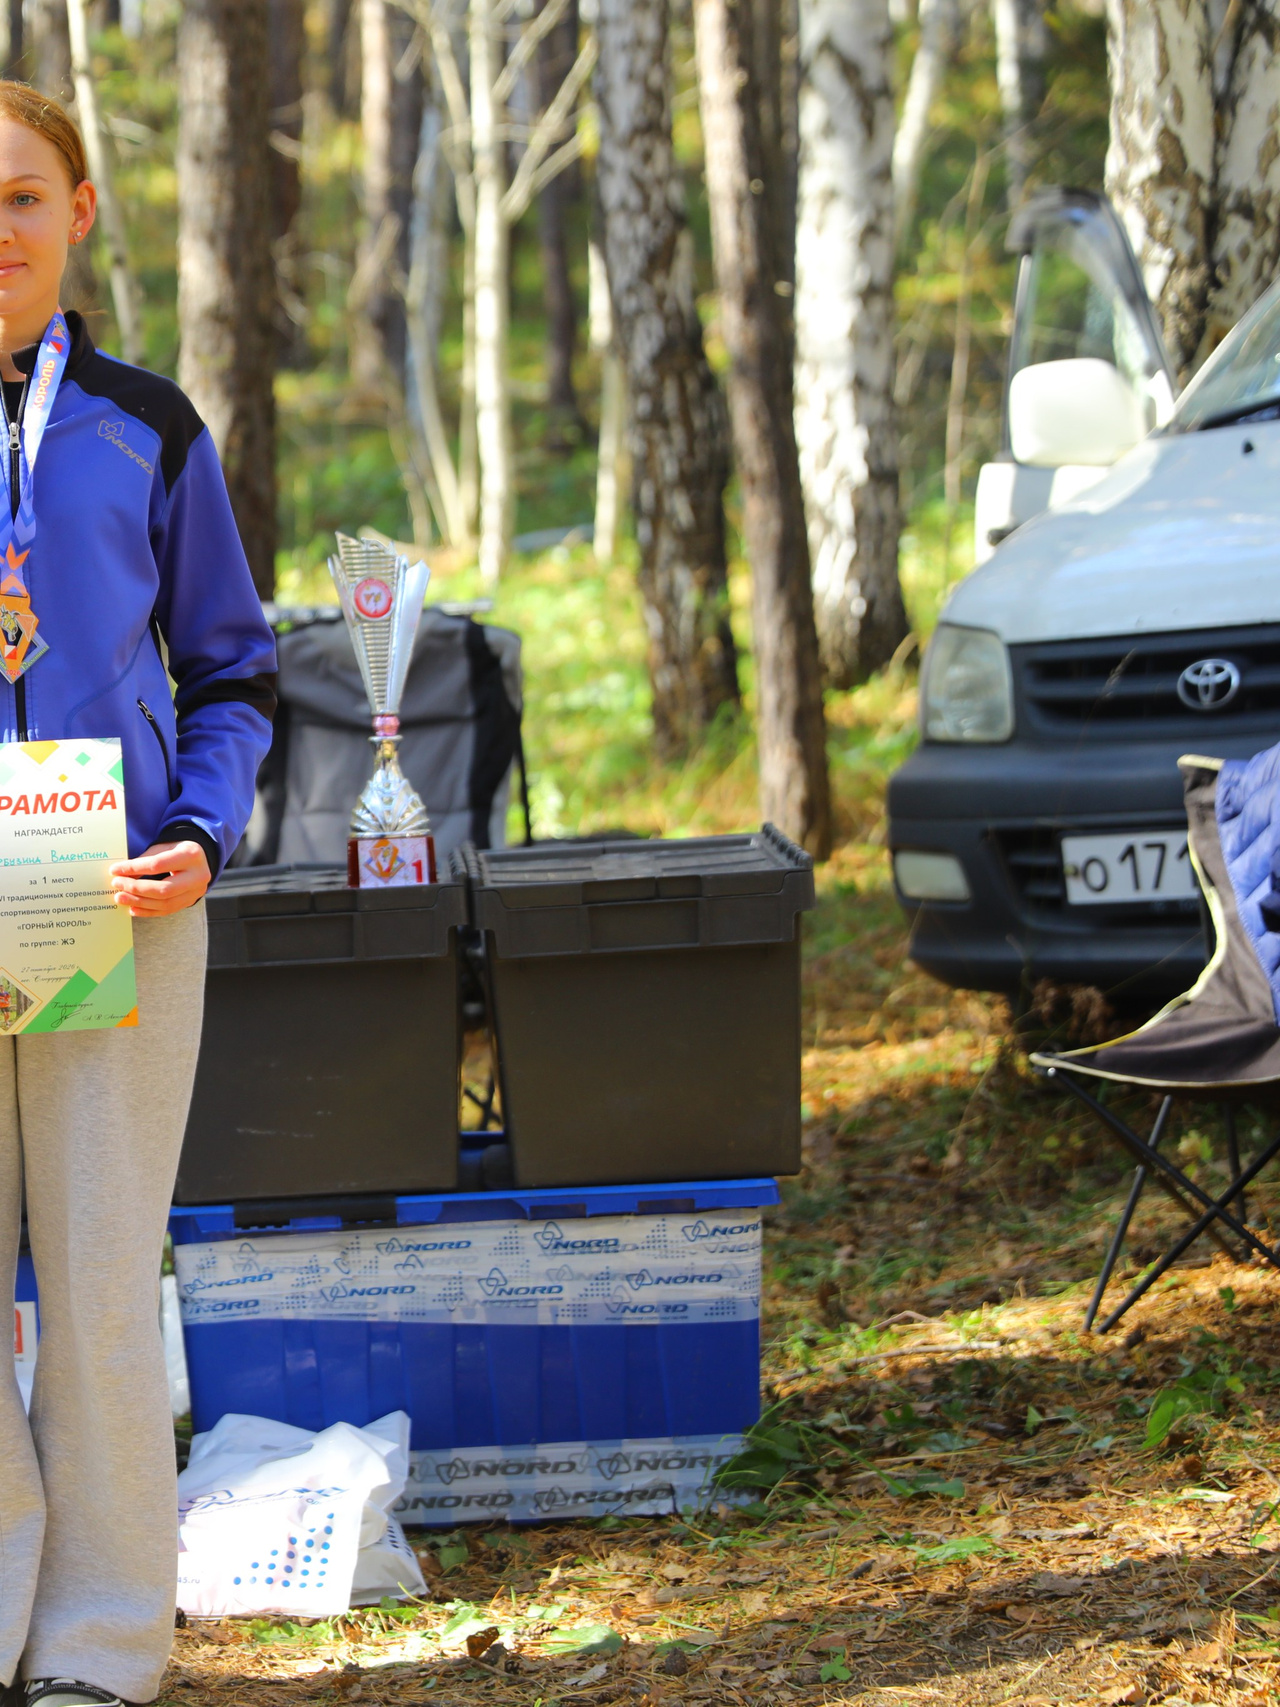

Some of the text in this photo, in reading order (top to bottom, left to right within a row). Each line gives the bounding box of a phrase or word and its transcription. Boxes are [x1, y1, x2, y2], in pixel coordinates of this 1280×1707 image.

[105, 435, 153, 475] NORD
[14, 826, 83, 837] НАГРАЖДАЕТСЯ
[411, 859, 424, 883] 1
[42, 876, 47, 884] 1
[7, 892, 64, 902] традиционных
[0, 908, 50, 917] спортивному
[52, 904, 118, 914] ориентированию
[17, 920, 91, 930] «ГОРНЫЙ КОРОЛЬ»
[31, 940, 59, 948] группе:
[61, 938, 75, 946] ЖЭ
[403, 1240, 472, 1251] NORD
[552, 1238, 619, 1249] NORD
[205, 1273, 273, 1288] NORD
[654, 1273, 723, 1285] NORD
[348, 1285, 416, 1297] NORD
[496, 1285, 564, 1296] NORD
[189, 1299, 260, 1314] NORD
[620, 1304, 688, 1314] NORD
[472, 1461, 576, 1477] NORD
[408, 1493, 514, 1510] NORD
